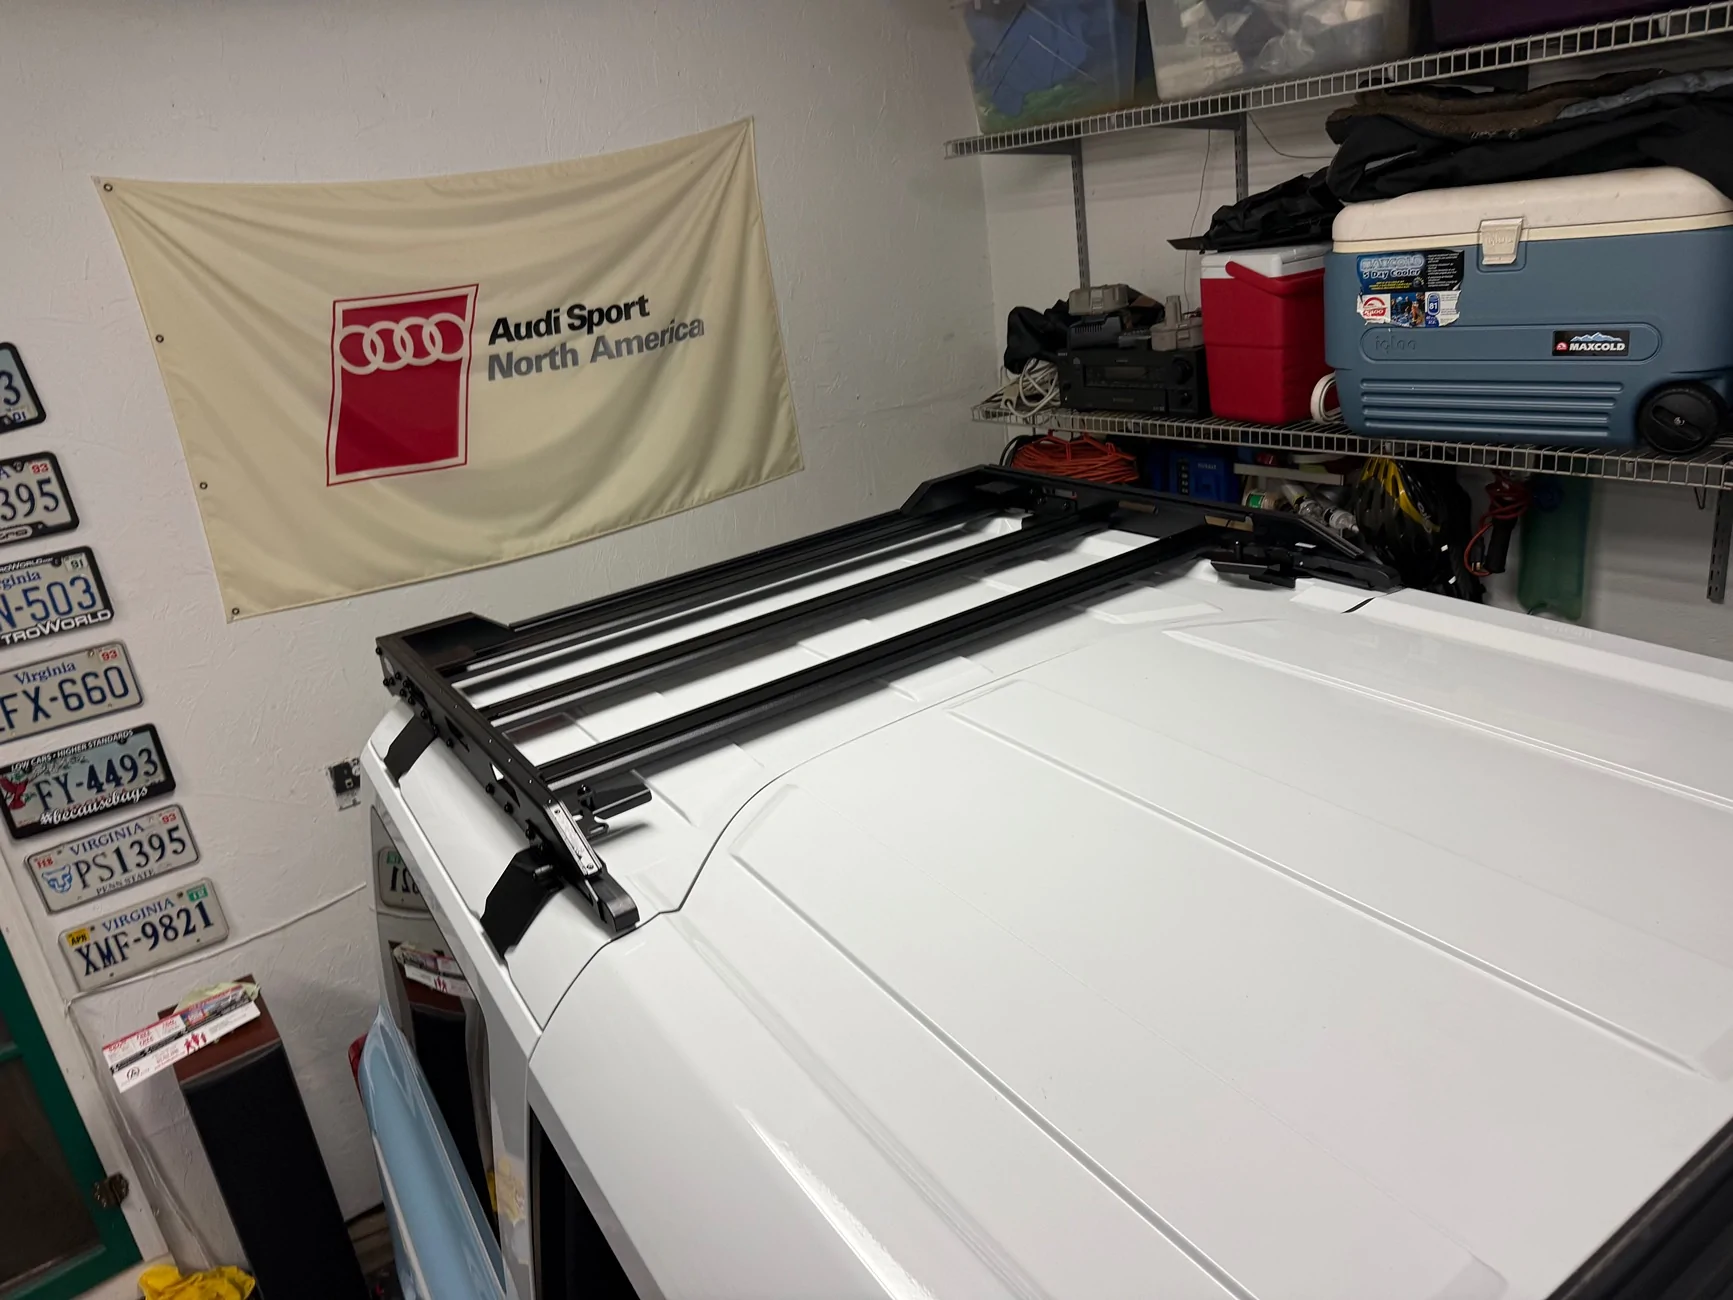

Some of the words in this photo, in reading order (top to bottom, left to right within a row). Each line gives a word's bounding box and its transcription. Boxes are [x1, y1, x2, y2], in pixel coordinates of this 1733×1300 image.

[1371, 270, 1389, 279] Day
[1390, 268, 1421, 277] Cooler
[488, 308, 562, 346] Audi
[566, 294, 650, 335] Sport
[1429, 302, 1438, 310] 81
[488, 342, 579, 381] North
[590, 317, 705, 363] America
[1569, 342, 1626, 351] MAXCOLD
[0, 476, 60, 521] 395
[0, 570, 42, 590] ginia
[101, 649, 118, 661] 93
[14, 661, 76, 685] Virginia
[0, 666, 129, 732] FX-660
[11, 760, 29, 773] LOW
[31, 753, 52, 767] CARS
[57, 743, 87, 758] HIGHER
[88, 729, 133, 749] STANDARDS
[34, 747, 159, 812] FY-4493
[40, 785, 148, 826] #becausebags
[162, 812, 178, 824] 93
[70, 822, 145, 856] VIRGINIA
[73, 824, 187, 891] PS1395
[96, 879, 123, 896] PENN
[124, 868, 156, 886] STATE
[102, 897, 175, 932] VIRGINIA
[75, 900, 214, 977] XMF-9821
